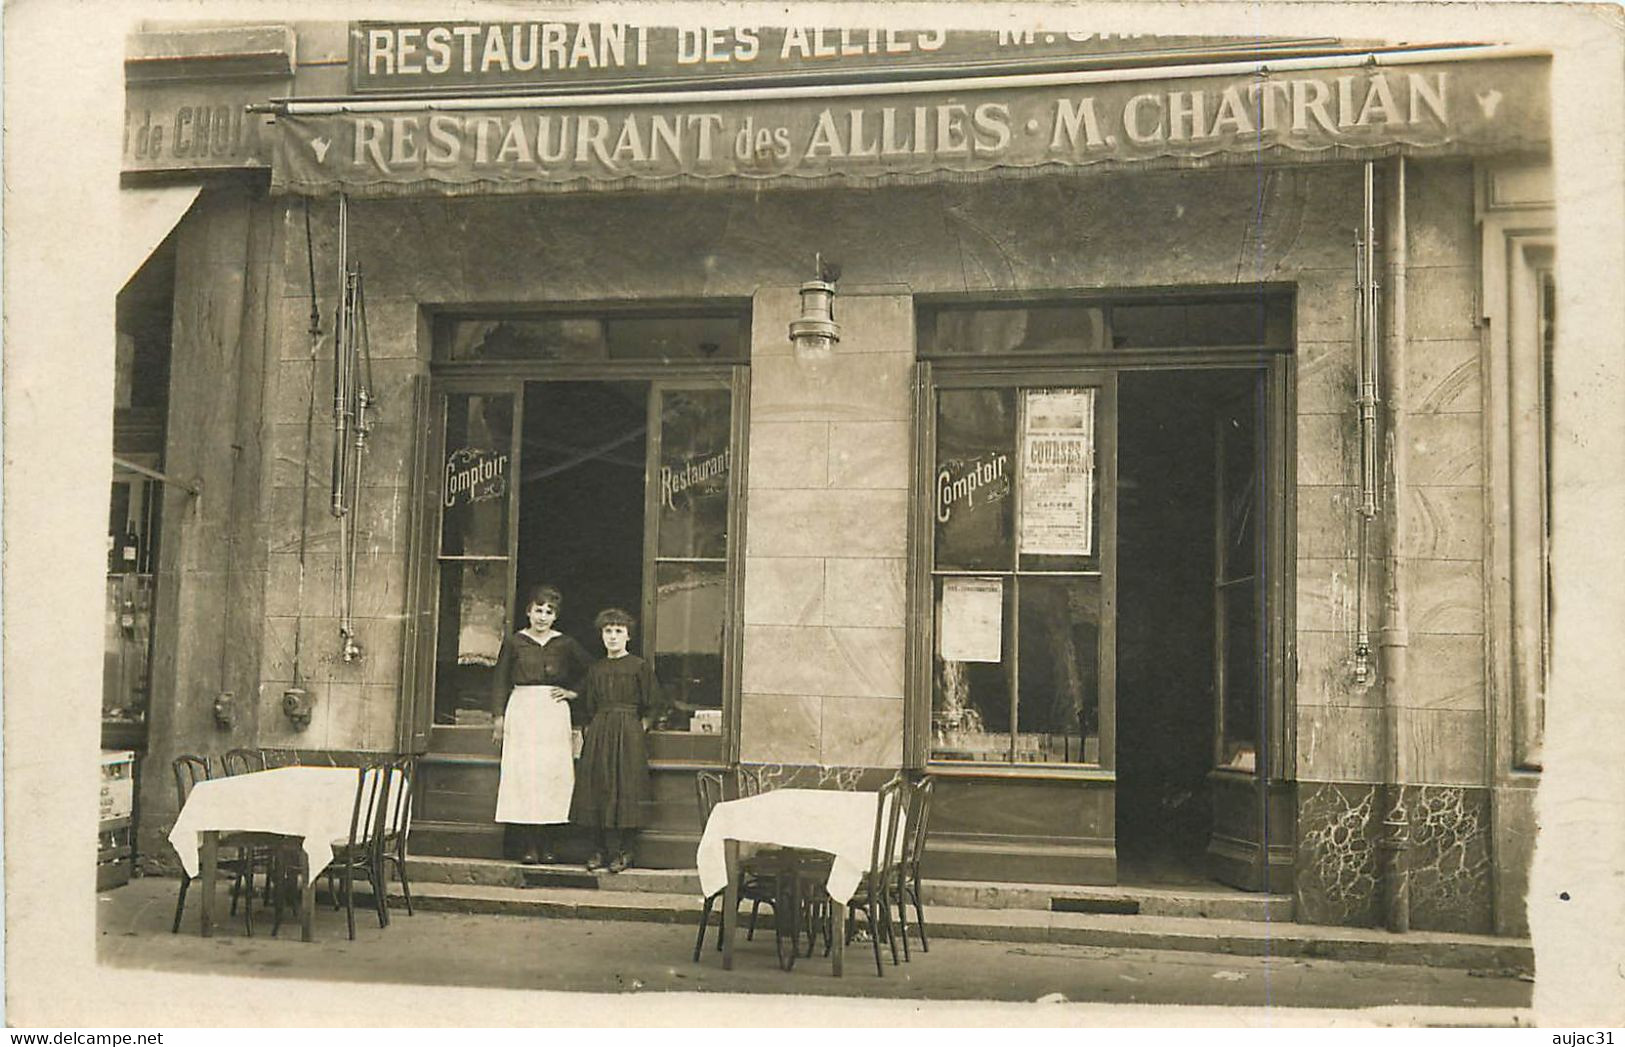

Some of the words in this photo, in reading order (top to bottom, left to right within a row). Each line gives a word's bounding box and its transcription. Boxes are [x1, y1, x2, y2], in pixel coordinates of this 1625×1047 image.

[368, 22, 648, 75] RESTAURANT
[677, 26, 759, 64] DES
[353, 112, 724, 173] RESTAURANT
[734, 116, 792, 161] des
[804, 98, 1012, 159] ALLIÉS
[1049, 96, 1117, 150] M.
[1123, 71, 1449, 143] CHATRIAN
[444, 452, 508, 508] Comptoir
[660, 449, 730, 511] Restaurant
[937, 452, 1007, 523] Comptoir
